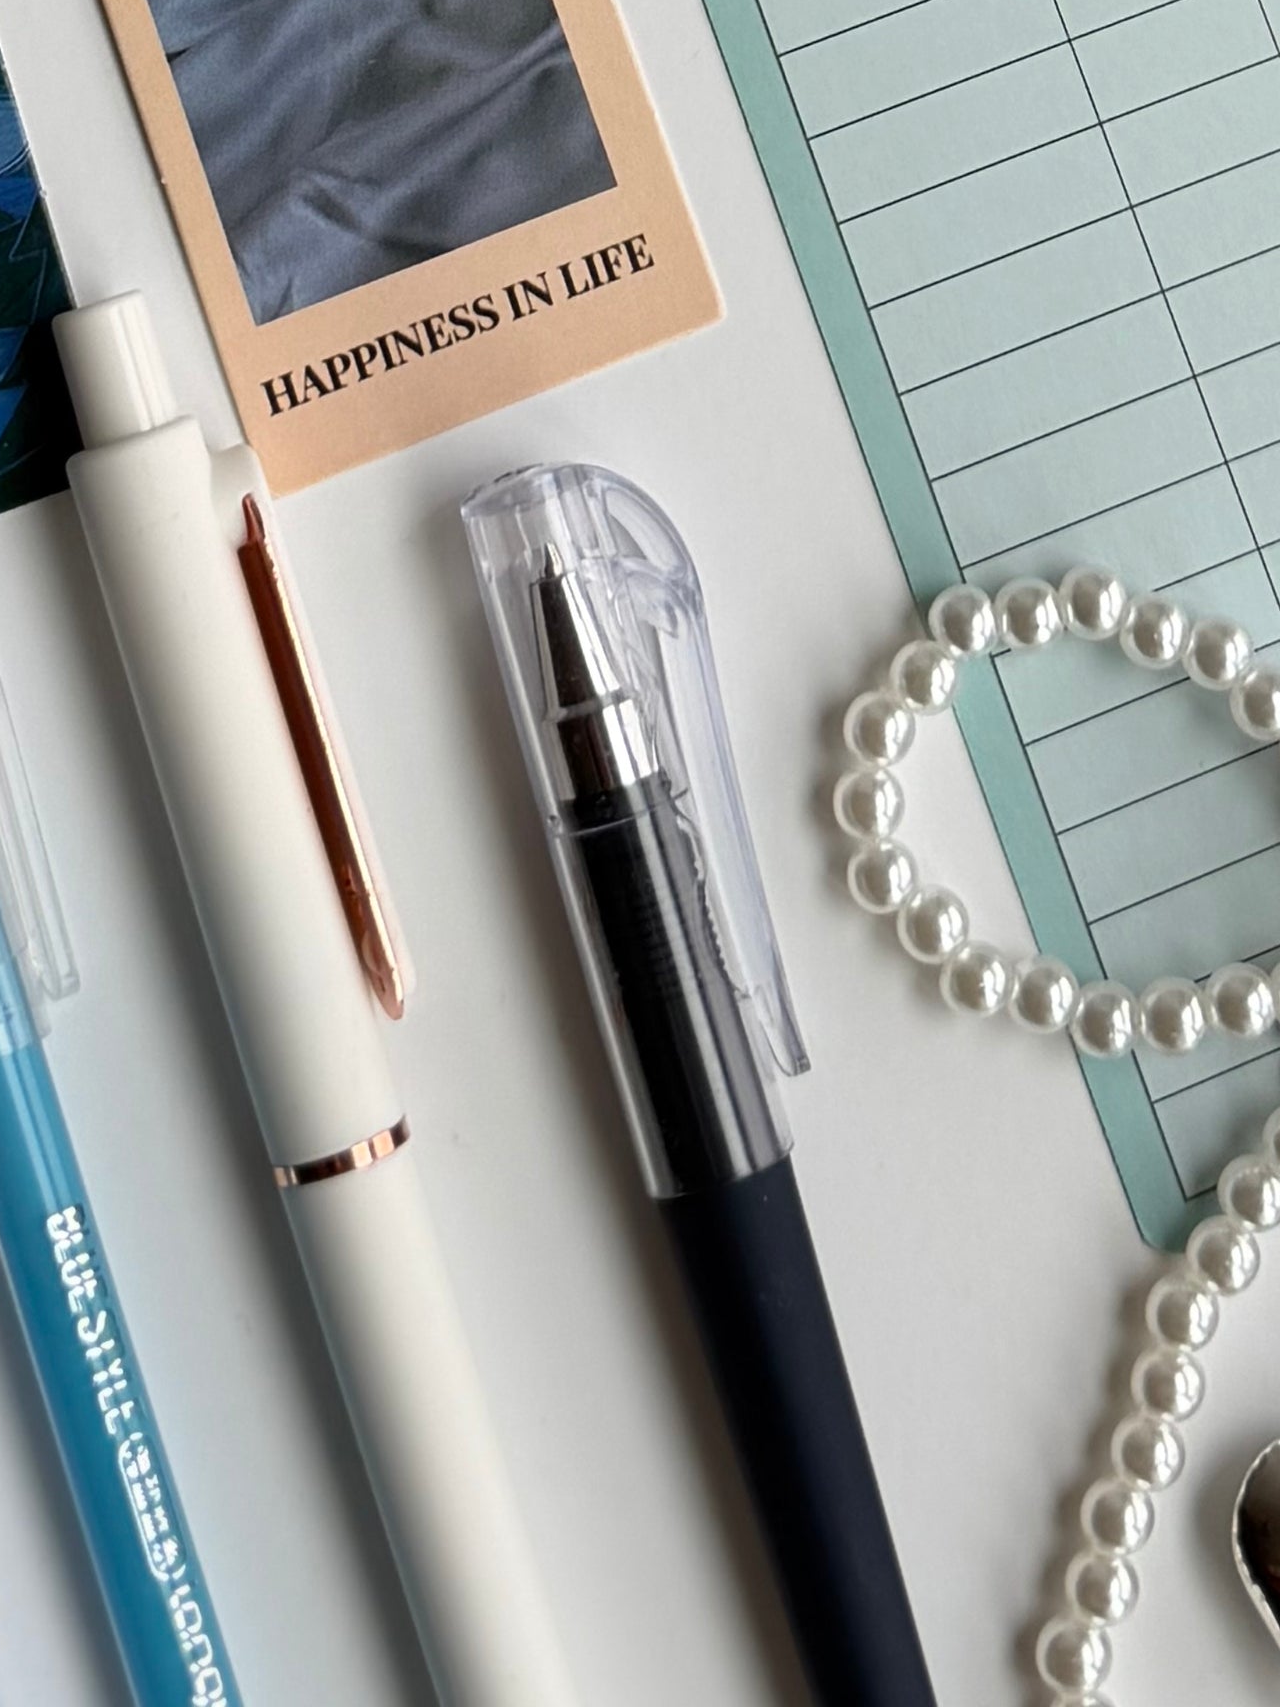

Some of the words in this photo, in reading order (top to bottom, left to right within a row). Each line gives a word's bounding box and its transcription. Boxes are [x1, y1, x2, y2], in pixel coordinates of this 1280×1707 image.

[260, 293, 500, 417] HAPPINESS
[502, 271, 556, 322] IN
[559, 233, 655, 301] LIFE
[47, 1203, 112, 1315] BLUE
[77, 1307, 144, 1436] STYLE
